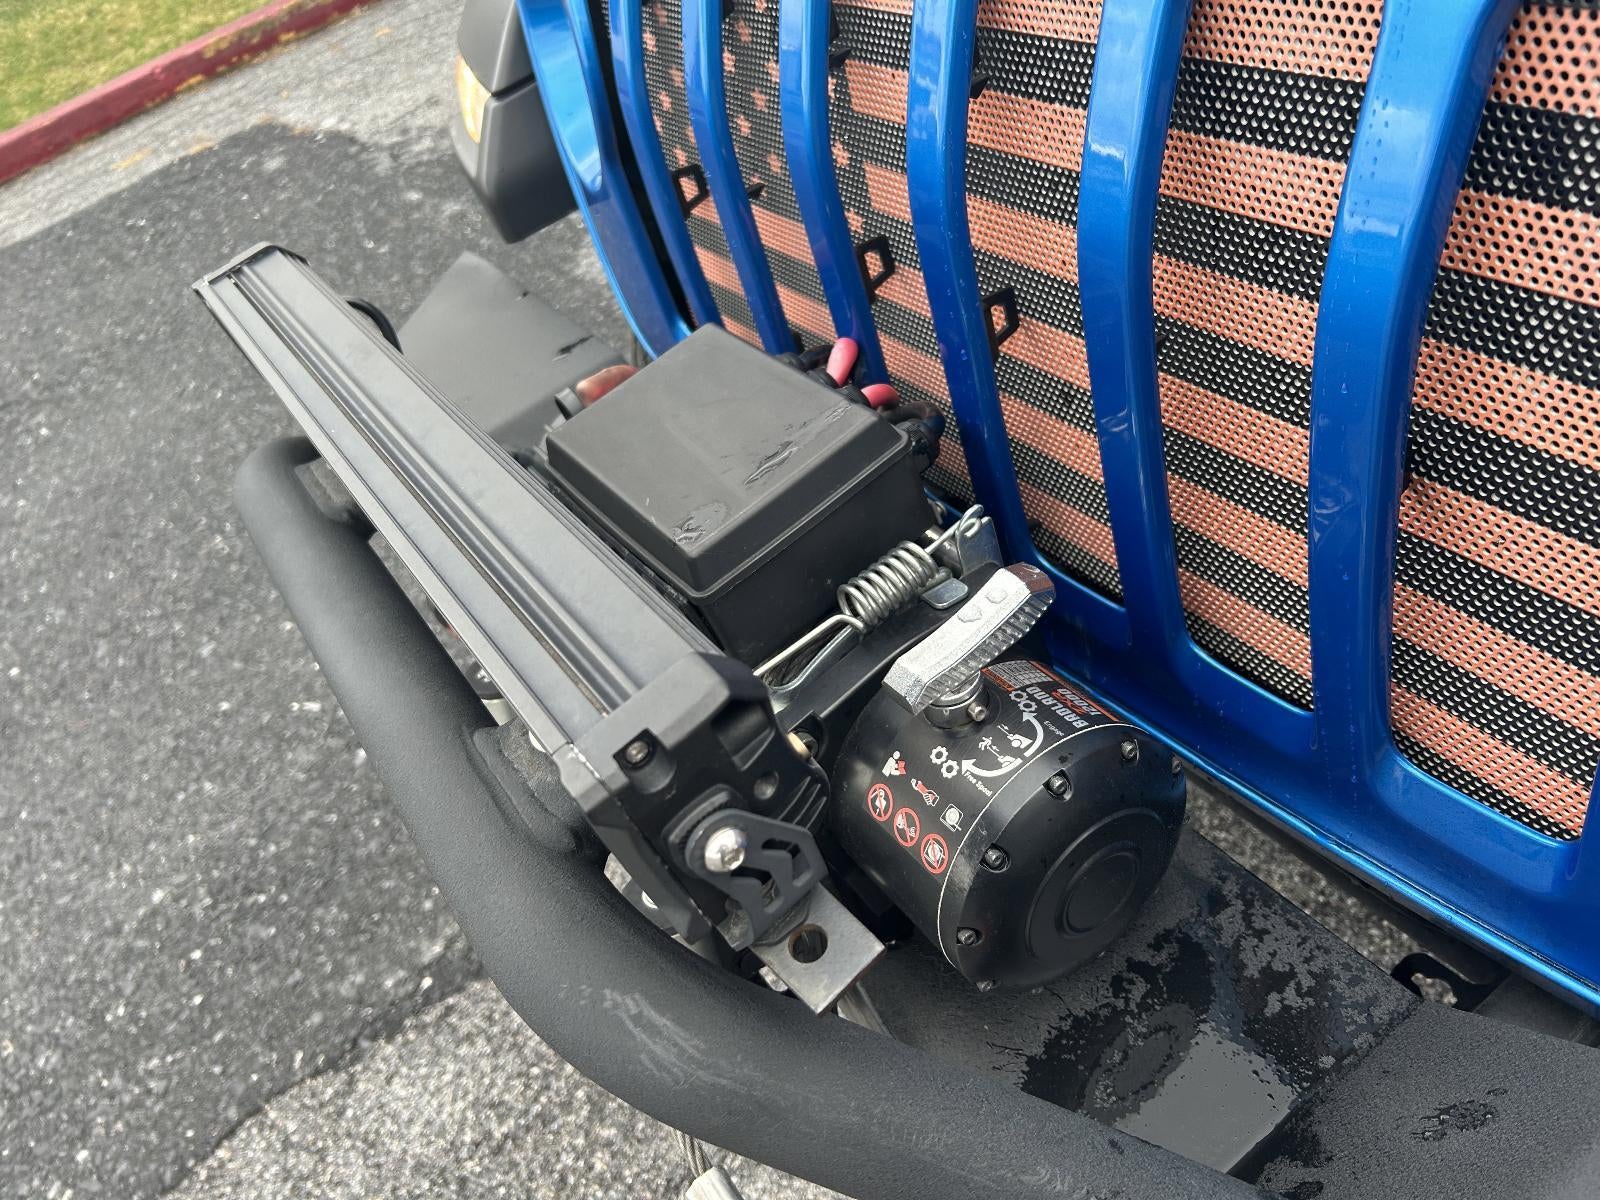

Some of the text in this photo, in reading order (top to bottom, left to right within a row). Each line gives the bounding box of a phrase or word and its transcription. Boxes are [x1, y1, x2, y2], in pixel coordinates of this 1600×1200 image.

[1026, 686, 1089, 729] BADLAND
[1057, 688, 1102, 716] 12000
[963, 771, 993, 797] Free Spool
